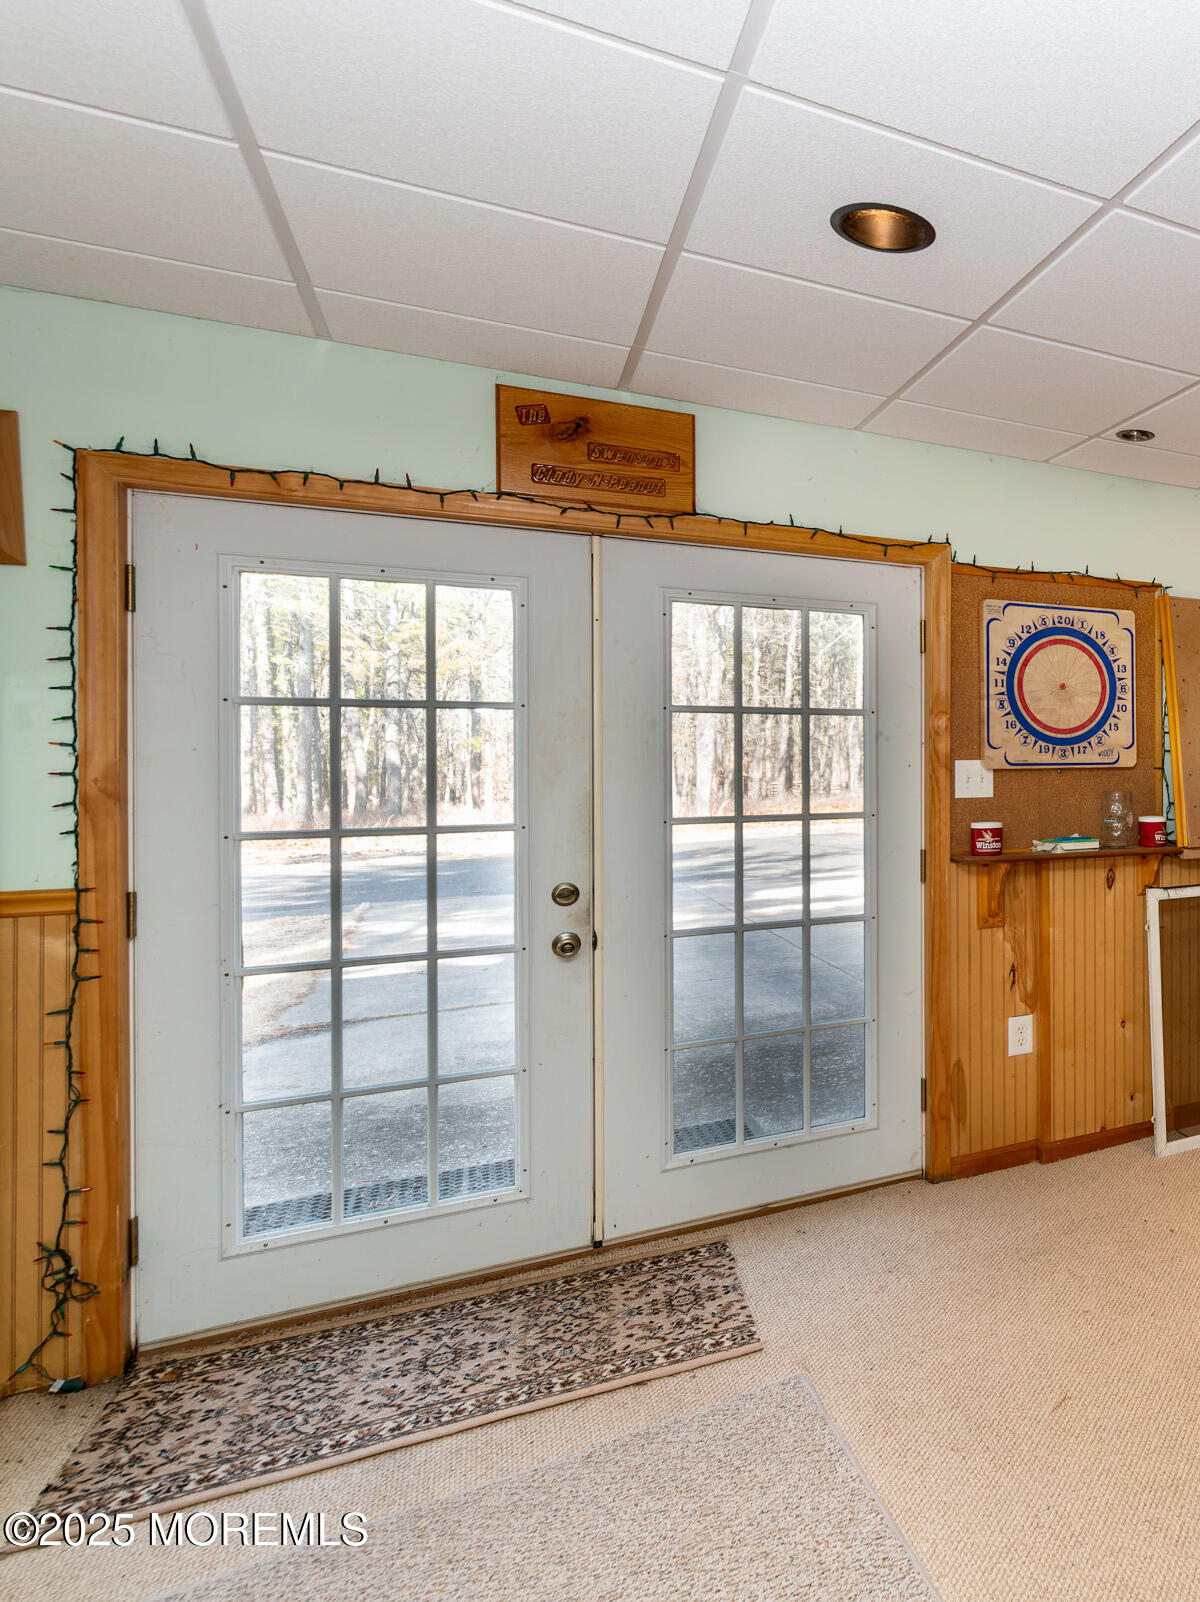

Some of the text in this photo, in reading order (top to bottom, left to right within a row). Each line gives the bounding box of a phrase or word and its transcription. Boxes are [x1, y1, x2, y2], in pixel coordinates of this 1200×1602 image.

[521, 408, 545, 423] The
[1056, 616, 1071, 625] 20
[1021, 625, 1031, 634] 12
[1095, 631, 1106, 639] 18
[1008, 639, 1016, 648] 9
[996, 657, 1007, 666] 14
[1117, 665, 1127, 673] 13
[994, 679, 1005, 687] 11
[1120, 685, 1126, 693] 6
[998, 700, 1005, 709] 8
[1117, 704, 1127, 713] 10
[1005, 720, 1017, 729] 16
[1108, 723, 1119, 731] 15
[1096, 736, 1103, 744] 2
[1038, 745, 1050, 754] 19
[1077, 746, 1087, 754] 17
